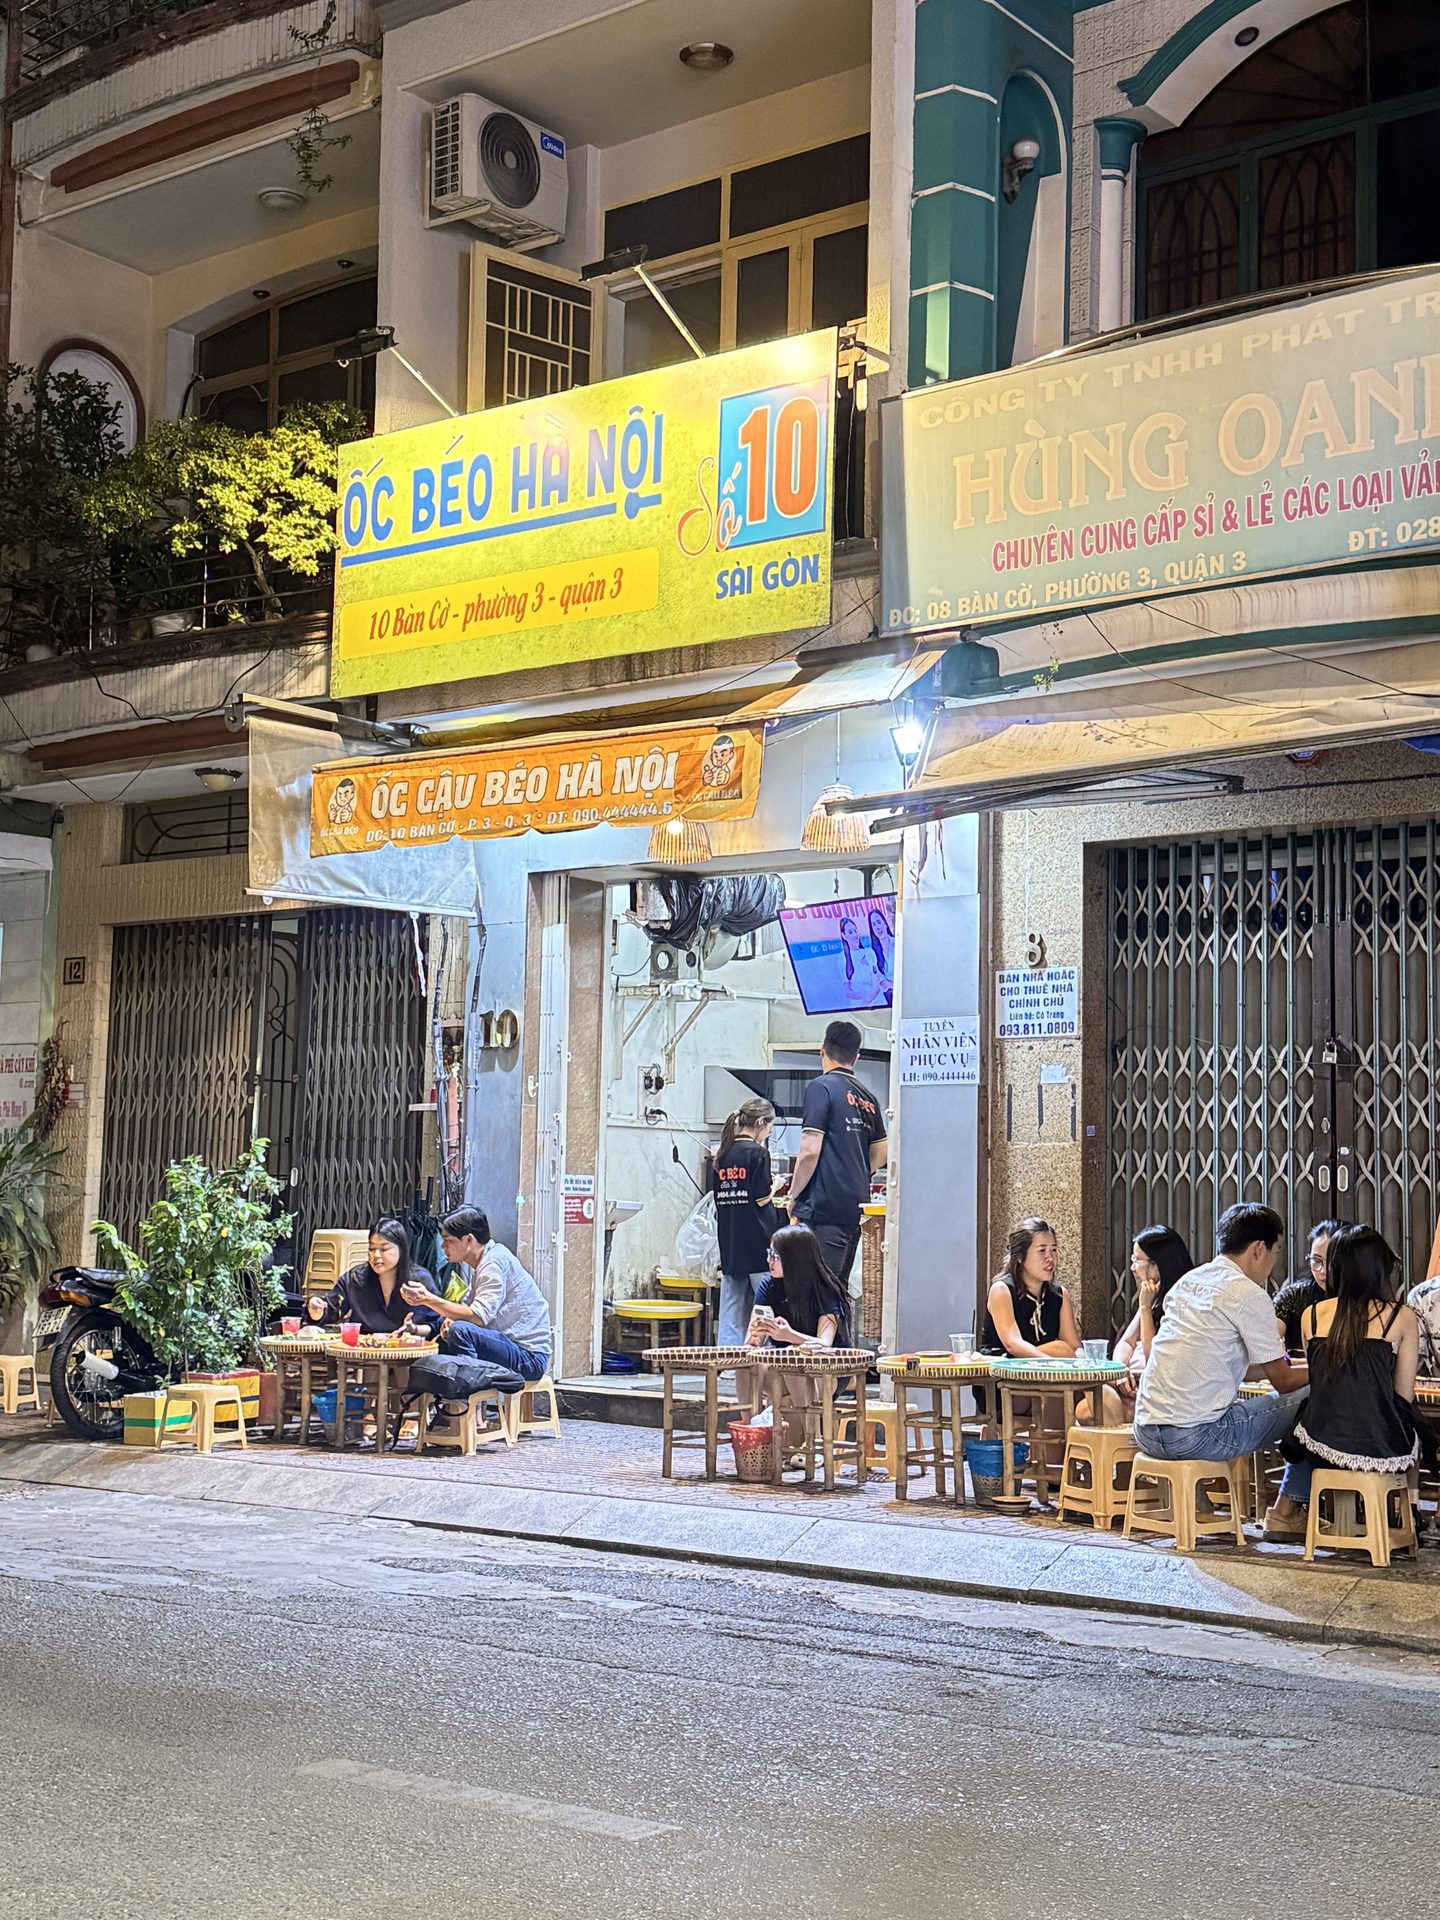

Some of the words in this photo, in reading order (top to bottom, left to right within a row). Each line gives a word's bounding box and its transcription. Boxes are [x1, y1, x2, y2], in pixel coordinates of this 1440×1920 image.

[919, 388, 1026, 429] CÔNG
[1037, 372, 1090, 402] TY
[1103, 342, 1223, 388] TNHH
[1241, 308, 1366, 358] PHÁT
[343, 457, 395, 547] ỐC
[411, 434, 493, 535] BÉO
[511, 412, 569, 514] HÀ
[586, 405, 664, 519] NỘI
[676, 456, 742, 559] Số
[738, 396, 820, 526] 10
[953, 412, 1190, 530] HÙNG
[992, 523, 1075, 573] CHUYÊN
[1079, 516, 1138, 558] CUNG
[1143, 496, 1187, 546] CẤP
[1193, 491, 1215, 539] SỈ
[1221, 498, 1239, 533] &
[1246, 480, 1275, 528] LẺ
[1282, 474, 1330, 522] CÁC
[1337, 468, 1393, 514] LOẠI
[1347, 526, 1388, 552] ĐT:
[1396, 515, 1440, 544] 028
[715, 561, 753, 600] SÀI
[761, 551, 820, 591] GÒN
[926, 600, 952, 620] 08
[957, 590, 998, 617] BÀN
[1004, 582, 1037, 609] CỜ,
[1045, 570, 1130, 603] PHƯỜNG
[1137, 567, 1157, 588] 3,
[1164, 552, 1225, 585] QUẬN
[1232, 550, 1246, 571] 3
[369, 609, 390, 640] 10
[392, 603, 425, 637] Bàn
[428, 597, 451, 630] Cờ
[462, 585, 529, 632] phường
[532, 581, 545, 613] 3
[559, 571, 606, 615] quận
[610, 567, 624, 599] 3
[370, 769, 410, 820] ỐC
[415, 768, 478, 819] CẬU
[481, 760, 550, 808] BÉO
[554, 752, 603, 801] HÀ
[611, 744, 680, 799] NỘI
[389, 826, 406, 840] 10
[482, 817, 491, 830] 3
[522, 813, 532, 826] 3
[1026, 931, 1042, 966] 8
[69, 961, 81, 980] 12
[1023, 970, 1044, 982] NHÀ
[1000, 986, 1020, 997] CHO
[1024, 983, 1049, 995] THUÊ
[1052, 982, 1073, 994] NHÀ
[1009, 997, 1040, 1008] CHÍNH
[1043, 994, 1064, 1007] CHỦ
[480, 1009, 519, 1049] 10
[902, 1033, 940, 1049] NHÂN
[944, 1031, 977, 1048] VIÊN
[999, 1021, 1075, 1037] 093.811.0809
[902, 1072, 920, 1082] LH:
[910, 1053, 947, 1068] PHỤC
[950, 1052, 969, 1068] VỤ
